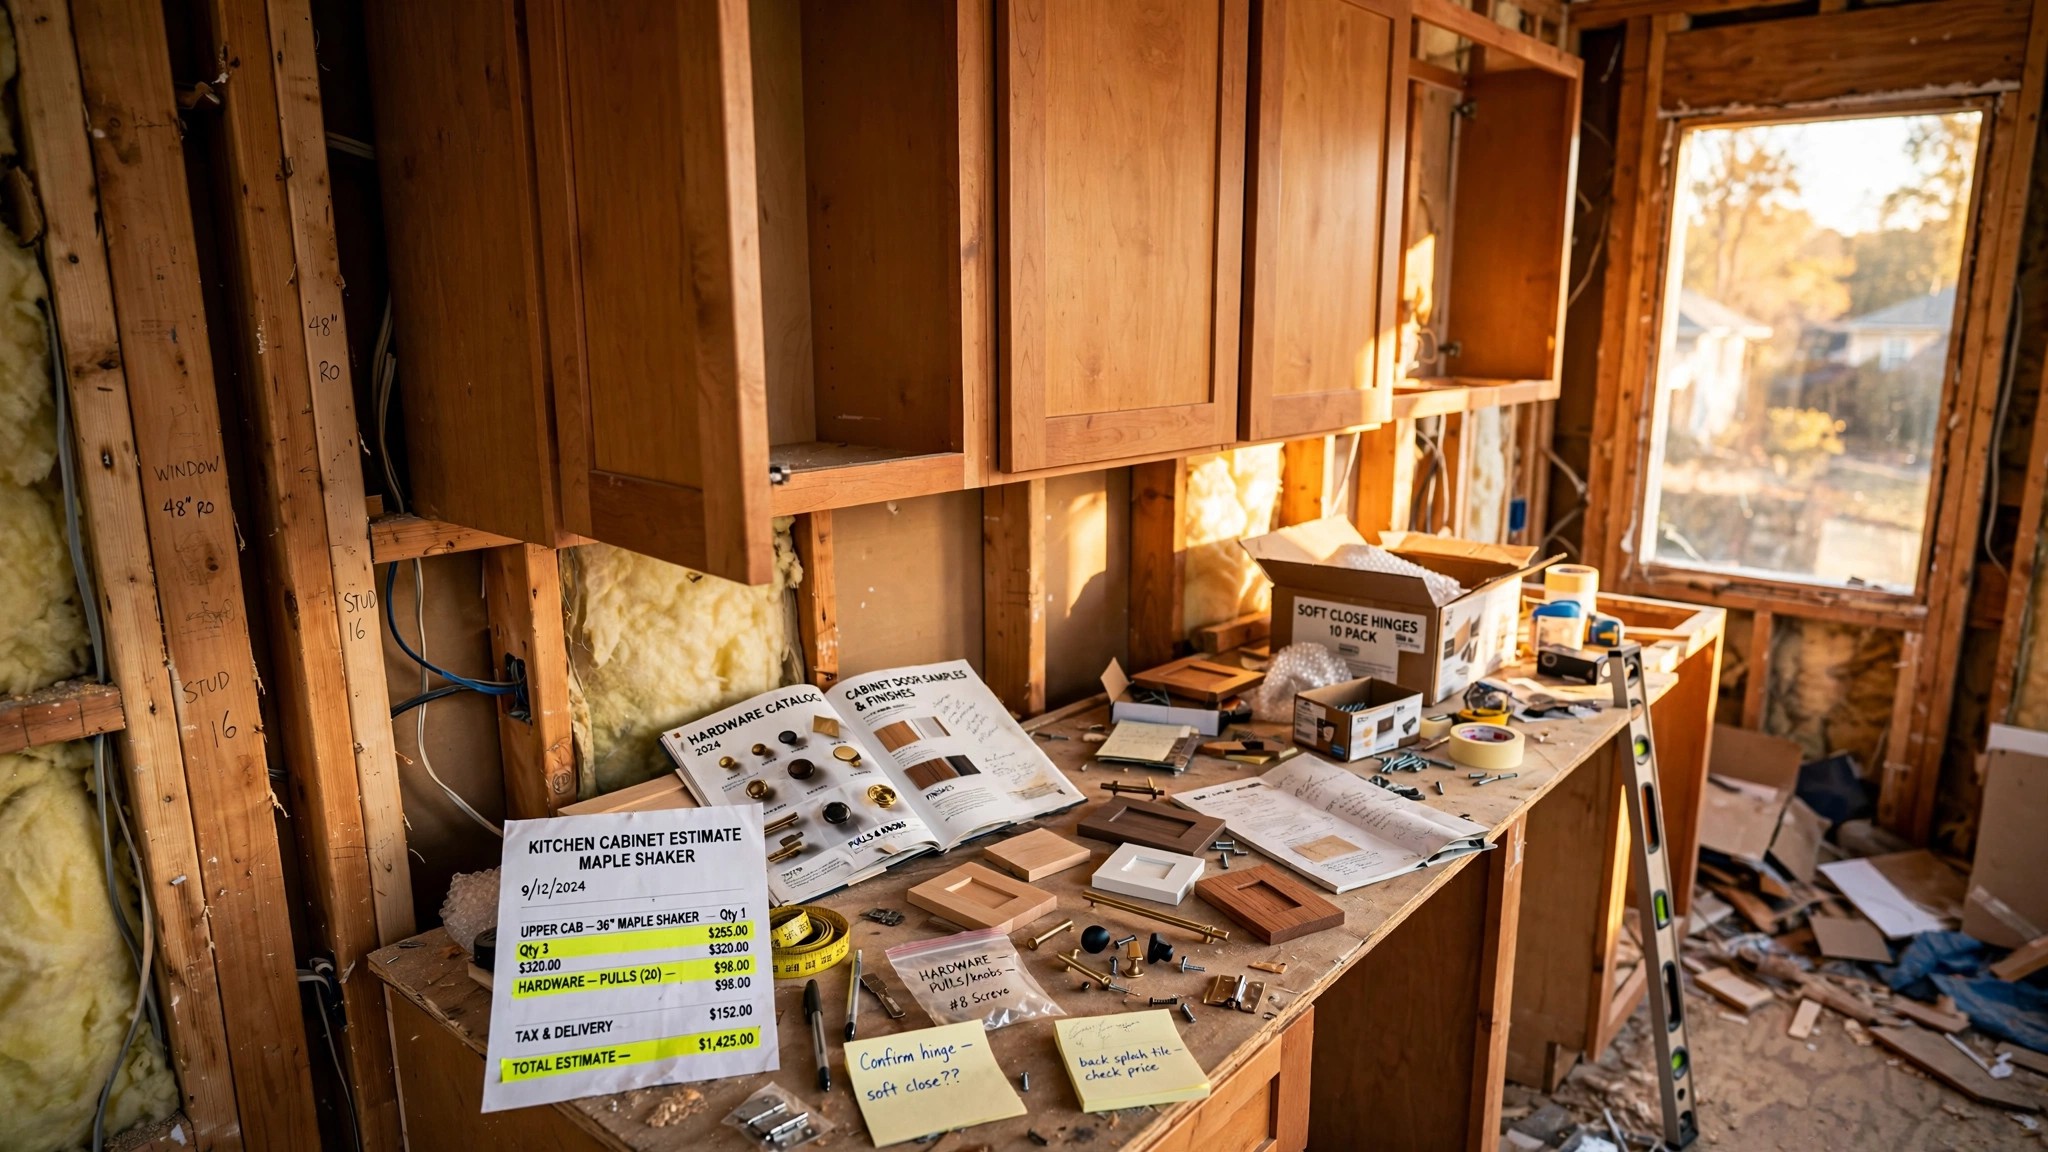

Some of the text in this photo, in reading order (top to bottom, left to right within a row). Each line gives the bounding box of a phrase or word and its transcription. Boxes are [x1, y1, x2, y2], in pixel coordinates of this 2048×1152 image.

[308, 314, 338, 337] 48"
[318, 360, 340, 382] RO
[153, 456, 220, 482] WINDOW
[197, 501, 214, 518] RO
[344, 590, 376, 613] STUD
[349, 618, 366, 642] 16
[1298, 604, 1418, 634] SOFT CLOSE HINGES
[1330, 625, 1377, 643] 10 PACK
[182, 672, 230, 704] STUD
[846, 670, 967, 700] CABINET DOOR SAMPLES
[854, 688, 916, 712] & FINISHES
[212, 710, 237, 748] 16
[687, 693, 822, 745] HARDWARE CATALOG
[694, 741, 722, 756] 2024
[528, 828, 742, 854] KITCHEN CABINET ESTIMATE
[578, 849, 696, 870] MAPLE SHAKER
[520, 877, 586, 900] 9/12/2024
[521, 924, 558, 938] UPPER
[560, 922, 584, 934] CAB
[618, 915, 653, 929] MAPLE
[656, 912, 700, 925] SHAKER
[720, 908, 738, 924] Qty
[740, 907, 746, 919] 1
[520, 926, 748, 958] Qty 3 $255.00
[519, 942, 750, 975] $320.00 $320.00
[919, 954, 991, 981] HARDWARE
[518, 976, 584, 994] HARDWARE
[600, 970, 636, 986] PULLS
[640, 968, 662, 984] (20)
[714, 960, 750, 974] $98.00
[714, 976, 751, 992] $98.00
[950, 996, 968, 1010] #8
[515, 1004, 752, 1044] TAX & DELIVERY $152.00
[512, 1060, 552, 1075] TOTAL
[556, 1050, 616, 1070] ESTIMATE
[698, 1033, 754, 1052] $1,425.00
[860, 1047, 914, 1071] Confirm
[920, 1042, 957, 1063] hinge
[1079, 1054, 1109, 1068] back
[1151, 1046, 1172, 1057] tile
[1085, 1063, 1159, 1080] check price
[866, 1068, 960, 1102] soft close??
